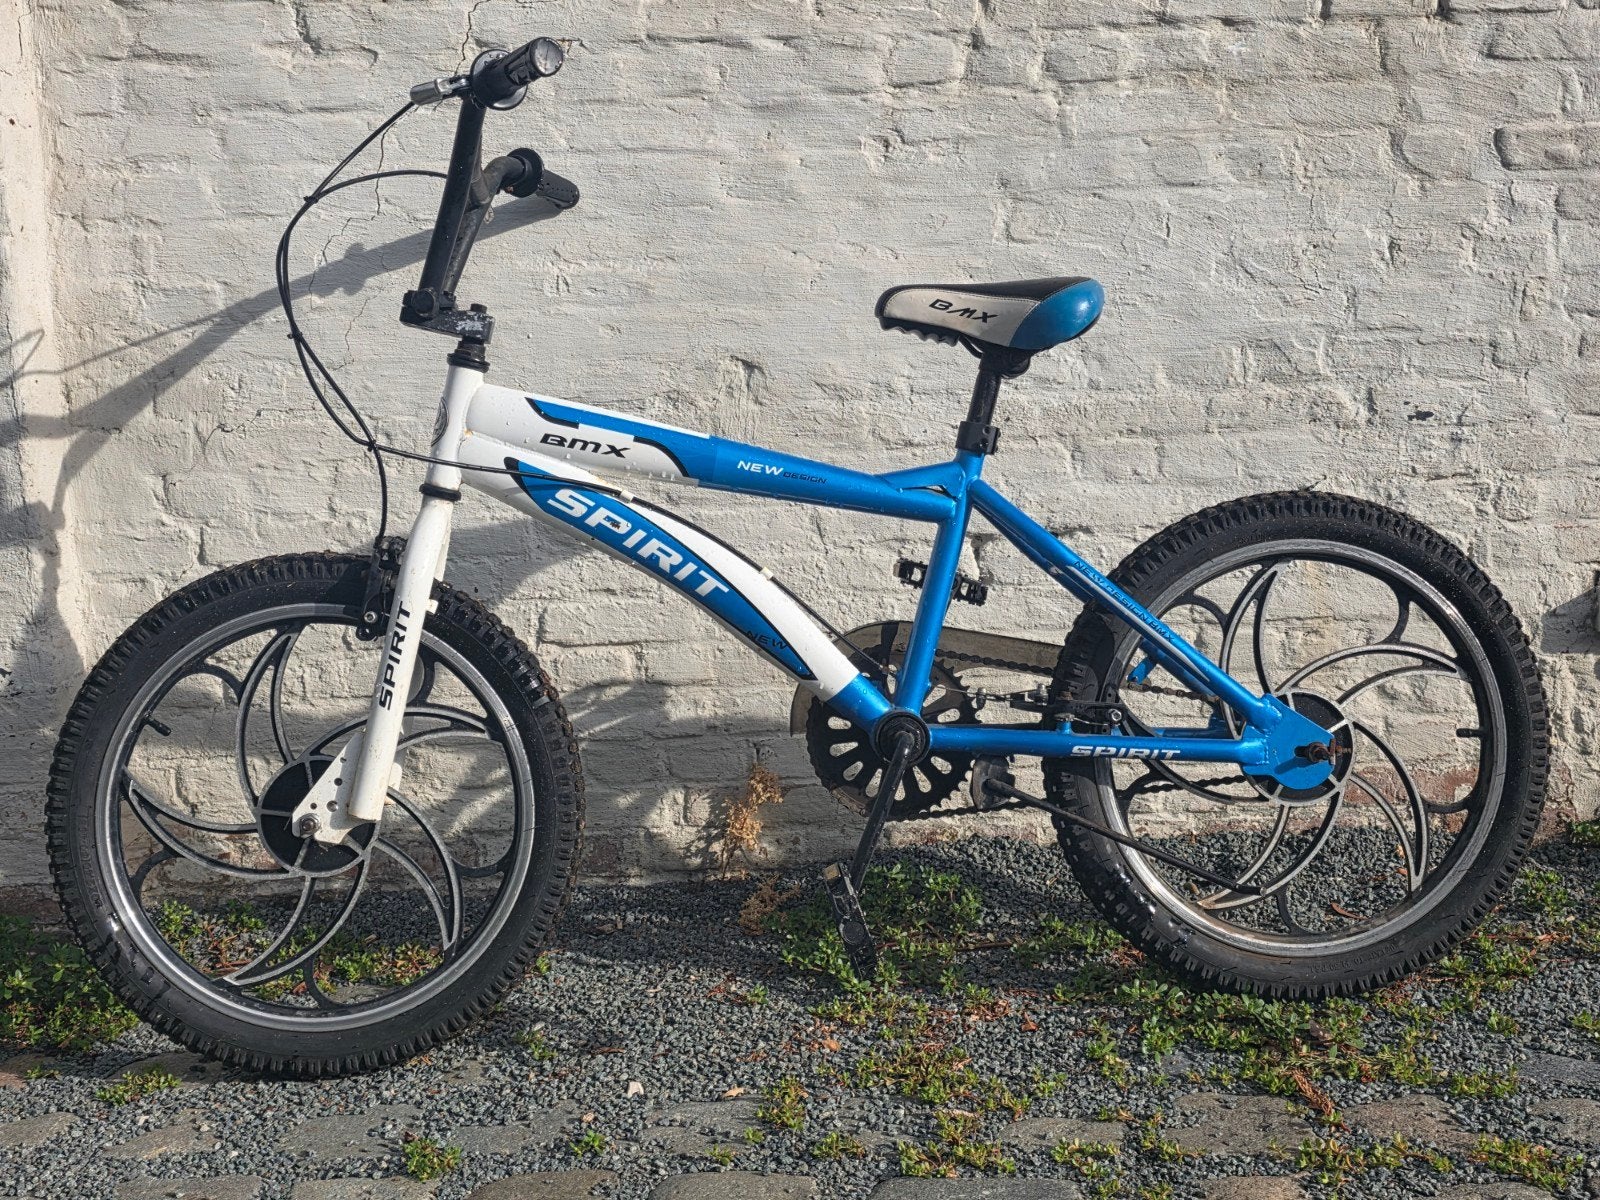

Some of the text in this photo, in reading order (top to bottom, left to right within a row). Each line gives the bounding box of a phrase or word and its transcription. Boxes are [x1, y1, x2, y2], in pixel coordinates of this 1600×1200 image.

[928, 298, 999, 324] BMX
[540, 433, 631, 458] BMX
[737, 460, 827, 484] NEW DESIGN
[547, 488, 730, 598] SPIRIT
[745, 630, 788, 650] NEW
[1148, 620, 1175, 642] BMX
[379, 600, 411, 711] SPIRIT
[1070, 745, 1181, 760] SPIRIT
